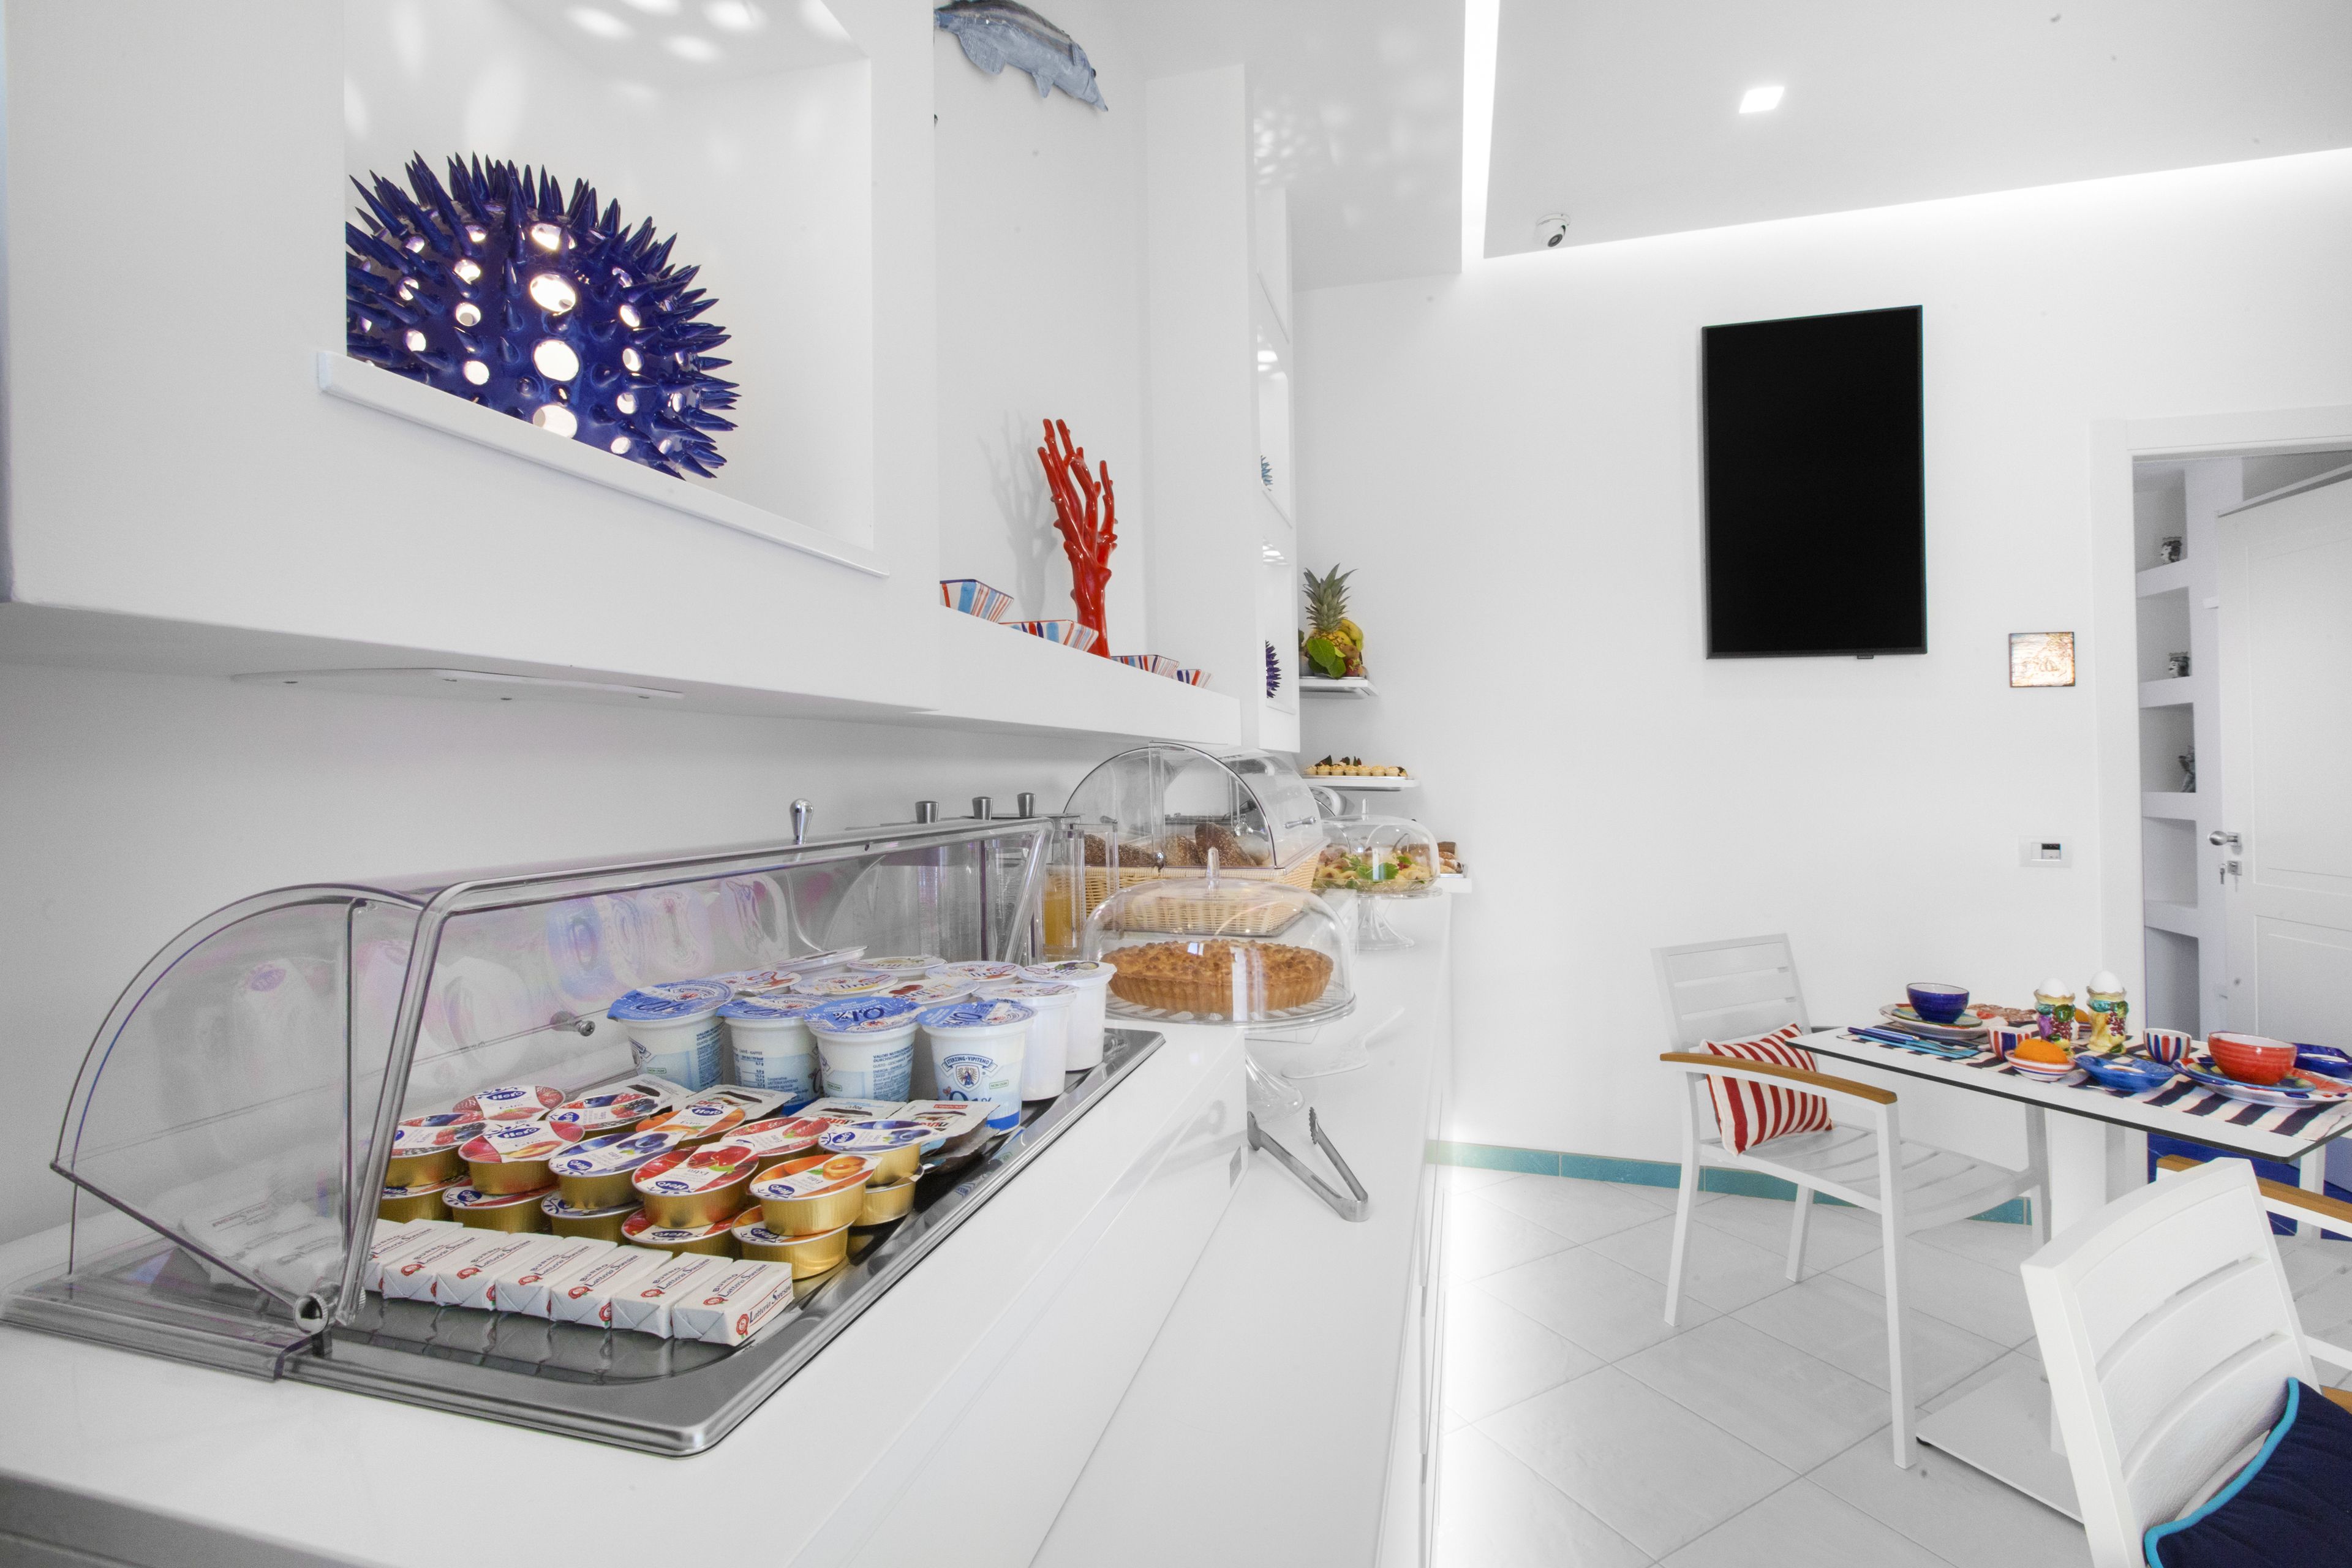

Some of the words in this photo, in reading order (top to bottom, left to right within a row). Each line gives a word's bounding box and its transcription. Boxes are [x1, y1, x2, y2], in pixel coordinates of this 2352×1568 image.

[946, 1056, 966, 1066] STERZING
[967, 1055, 990, 1065] VIPITENO
[492, 1091, 523, 1100] Hero
[503, 1128, 537, 1139] Hero
[570, 1159, 589, 1171] Hero
[658, 1181, 686, 1190] Hero
[771, 1185, 793, 1195] Hero
[753, 1229, 778, 1238] Hero
[534, 1259, 564, 1276] Latteria
[584, 1270, 614, 1287] Latteria
[656, 1273, 687, 1289] Latteria
[712, 1273, 738, 1292] BURRO
[717, 1279, 745, 1297] Latteria
[741, 1264, 767, 1280] Soresina
[749, 1301, 772, 1324] Latteria
